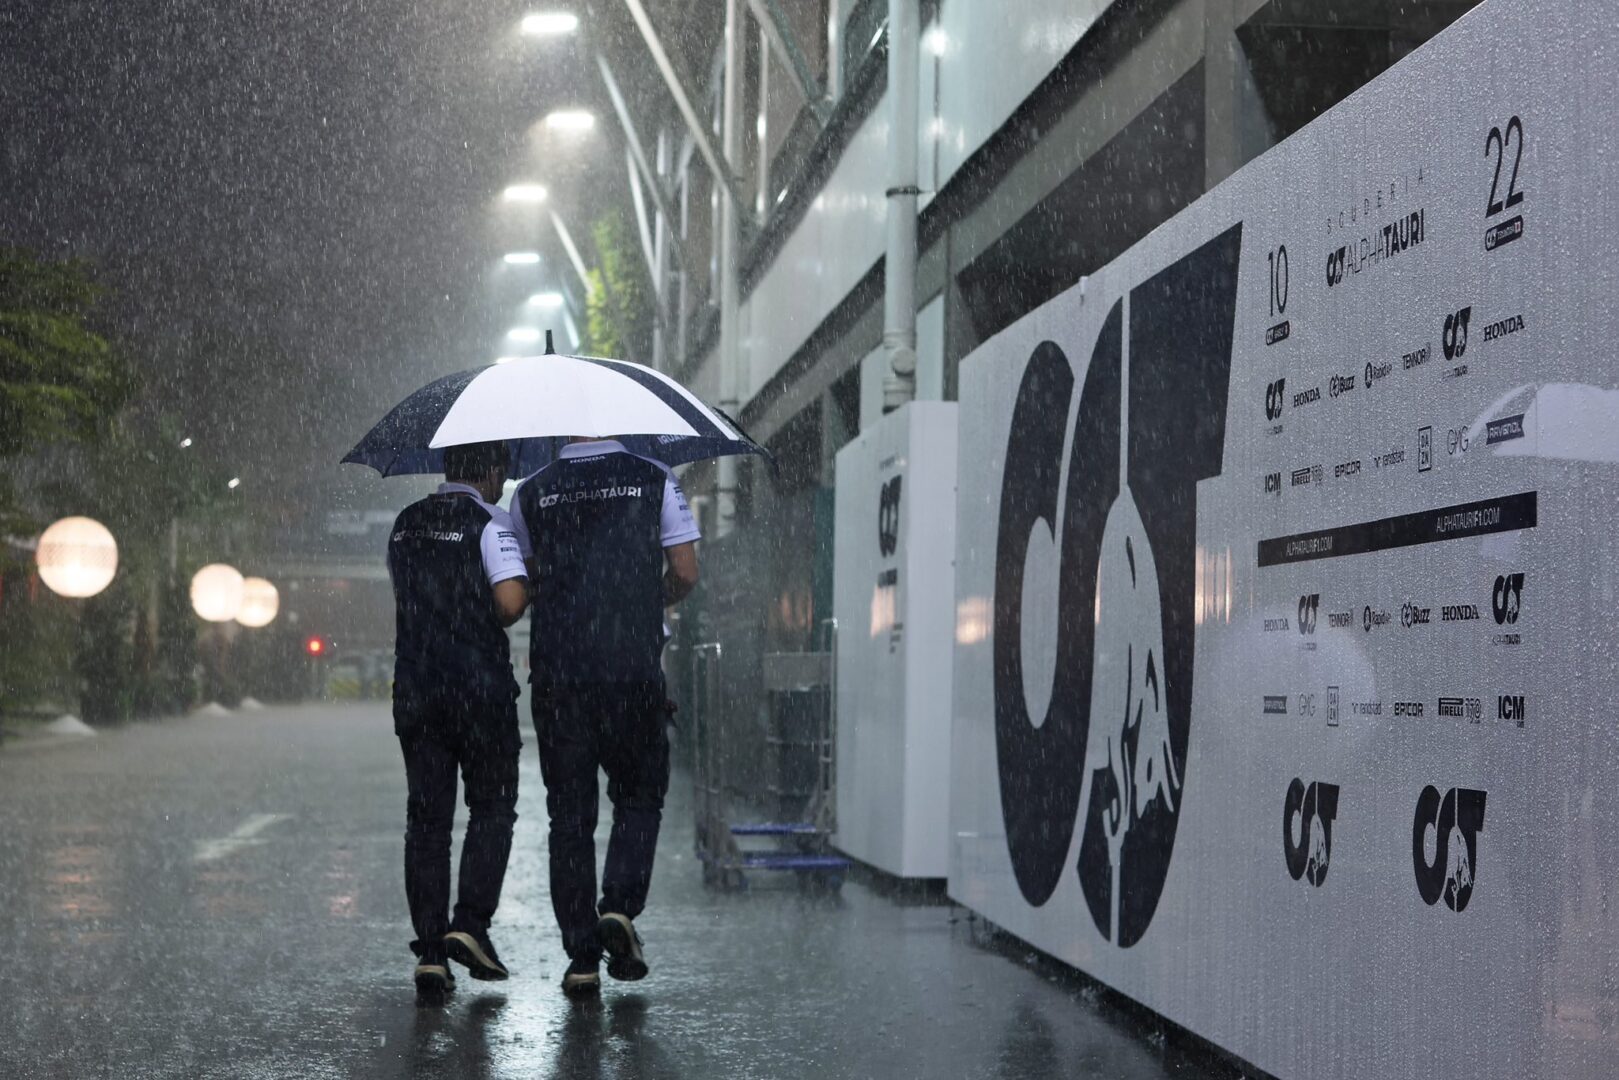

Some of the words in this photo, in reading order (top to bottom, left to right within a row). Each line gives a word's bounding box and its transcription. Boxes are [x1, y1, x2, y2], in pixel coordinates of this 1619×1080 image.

[1485, 115, 1524, 218] 22
[1347, 208, 1425, 278] ALPHATAURI
[1268, 244, 1289, 317] 10
[1484, 314, 1525, 342] HONDA
[1293, 387, 1321, 408] HONDA
[1264, 472, 1281, 493] ICM
[560, 486, 642, 504] ALPHATAURI
[1442, 604, 1480, 621] HONDA
[1264, 618, 1290, 632] HONDA
[1439, 698, 1463, 717] PIRELLI
[1498, 695, 1524, 720] ICM
